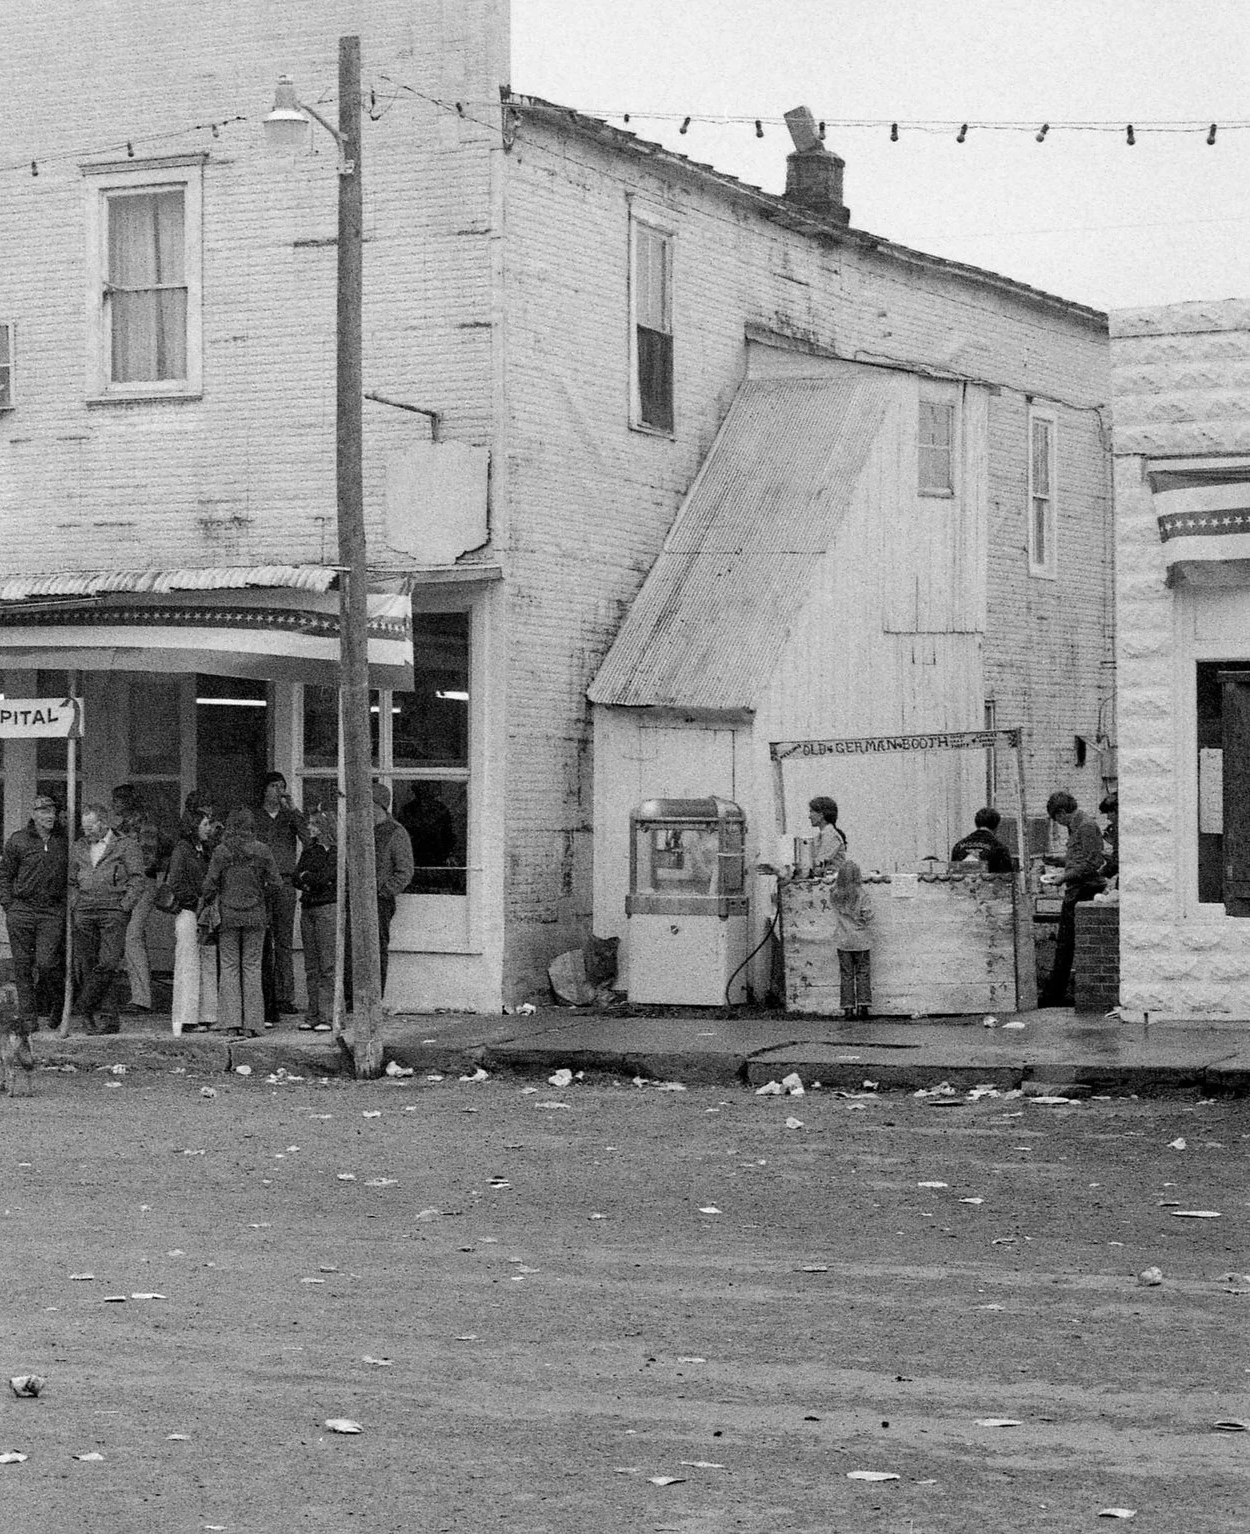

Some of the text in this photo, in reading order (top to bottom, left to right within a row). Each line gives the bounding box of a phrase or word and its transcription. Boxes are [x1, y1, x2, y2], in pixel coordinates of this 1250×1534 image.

[803, 743, 827, 756] OLD
[835, 739, 897, 755] GERMAN
[902, 736, 949, 750] BOOTH
